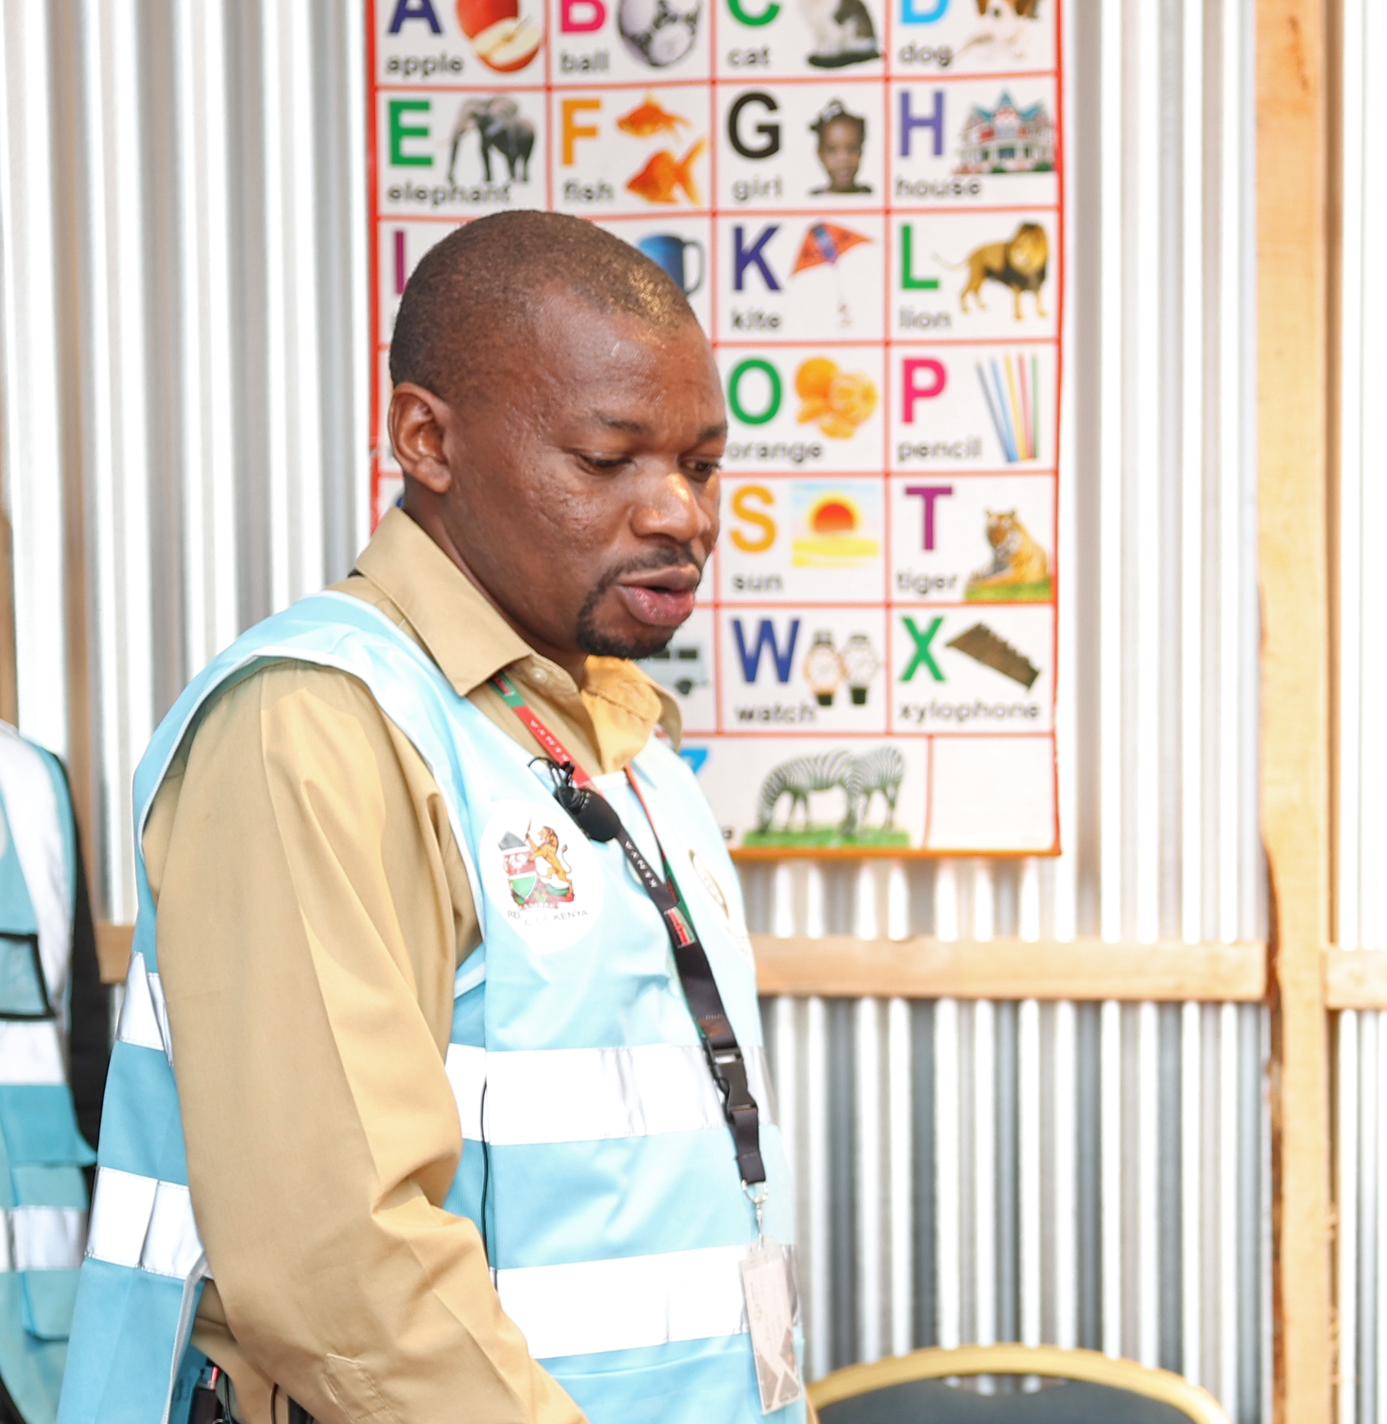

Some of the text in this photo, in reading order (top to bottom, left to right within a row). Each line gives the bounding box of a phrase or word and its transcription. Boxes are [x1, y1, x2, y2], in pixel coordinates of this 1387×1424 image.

[386, 52, 464, 77] apple
[560, 51, 609, 73] ball
[727, 46, 770, 67] cat
[899, 45, 952, 67] dog
[389, 99, 433, 167] E
[561, 99, 602, 167] F
[727, 91, 781, 160] G
[899, 91, 944, 157] H
[388, 182, 511, 206] elephant
[563, 180, 614, 201] fish
[732, 176, 783, 200] girl
[895, 177, 982, 198] house
[733, 225, 781, 292] K
[901, 224, 940, 290] L
[731, 308, 781, 330] kite
[899, 307, 951, 329] lion
[728, 357, 783, 427] O
[902, 357, 948, 425] P
[727, 442, 822, 464] orange
[898, 438, 982, 462] pencil
[730, 485, 778, 554] S
[904, 486, 953, 551] T
[733, 574, 783, 591] sun
[897, 572, 957, 595] tiger
[731, 619, 800, 683] W
[901, 616, 946, 683] X
[736, 701, 816, 723] watch
[899, 699, 1040, 724] xylophone
